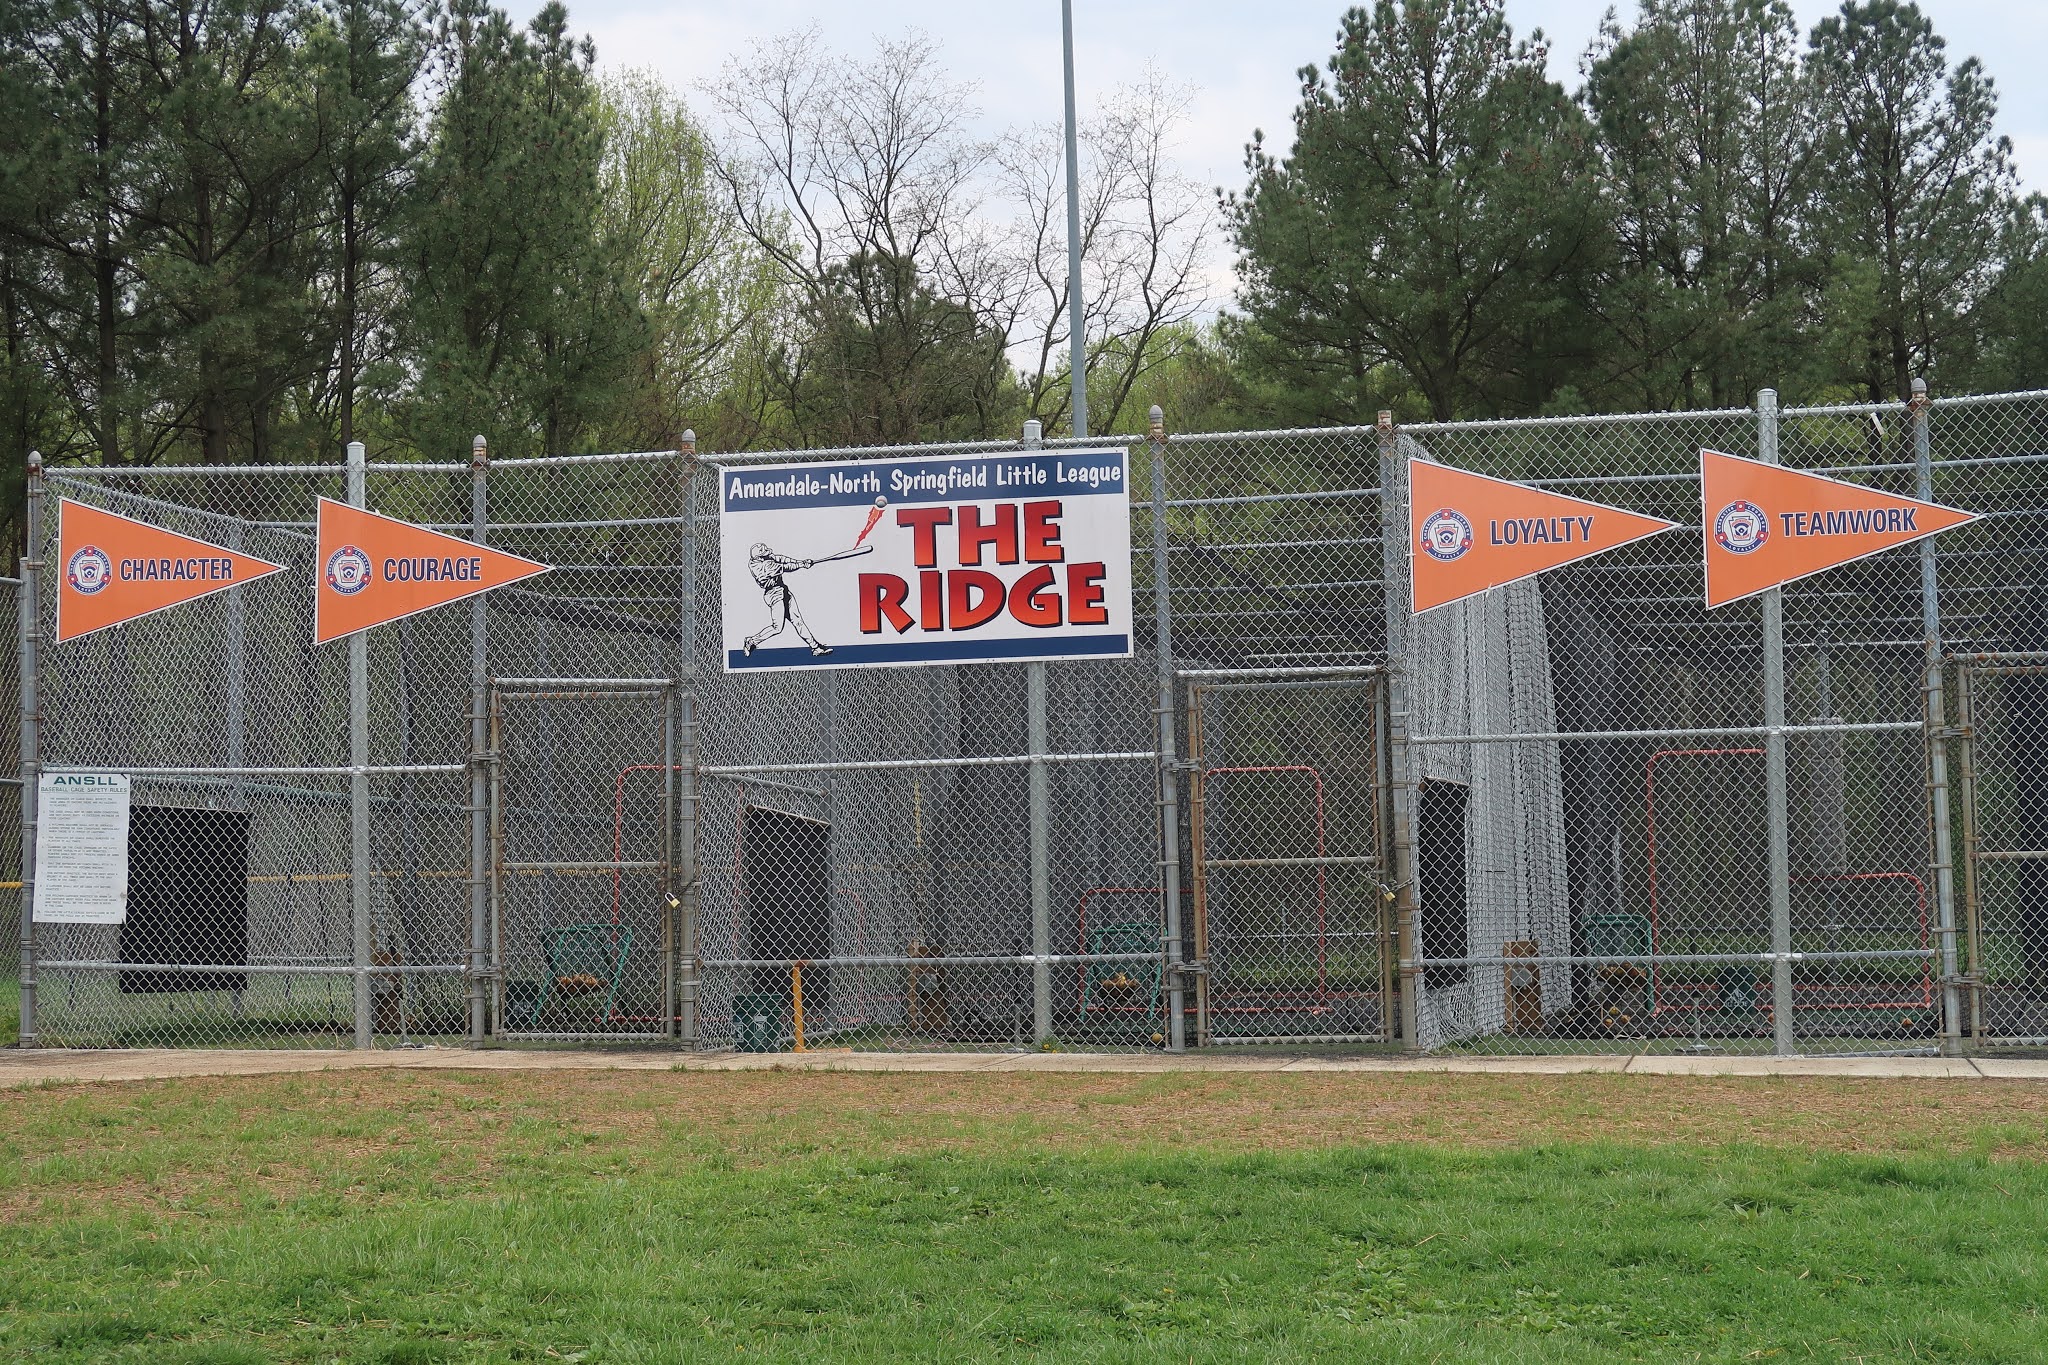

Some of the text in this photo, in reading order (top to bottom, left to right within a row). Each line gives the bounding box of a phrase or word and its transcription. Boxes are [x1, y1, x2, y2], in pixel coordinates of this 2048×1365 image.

[729, 462, 1122, 500] Annandale-North Springfield Little League
[896, 500, 1065, 568] THE
[1490, 516, 1594, 546] LOYALTY
[1780, 508, 1918, 537] TEAMWORK
[120, 558, 233, 581] CHARACTER
[383, 557, 481, 582] COURAGE
[858, 561, 1109, 634] RIDGE
[53, 776, 118, 786] ANSLL
